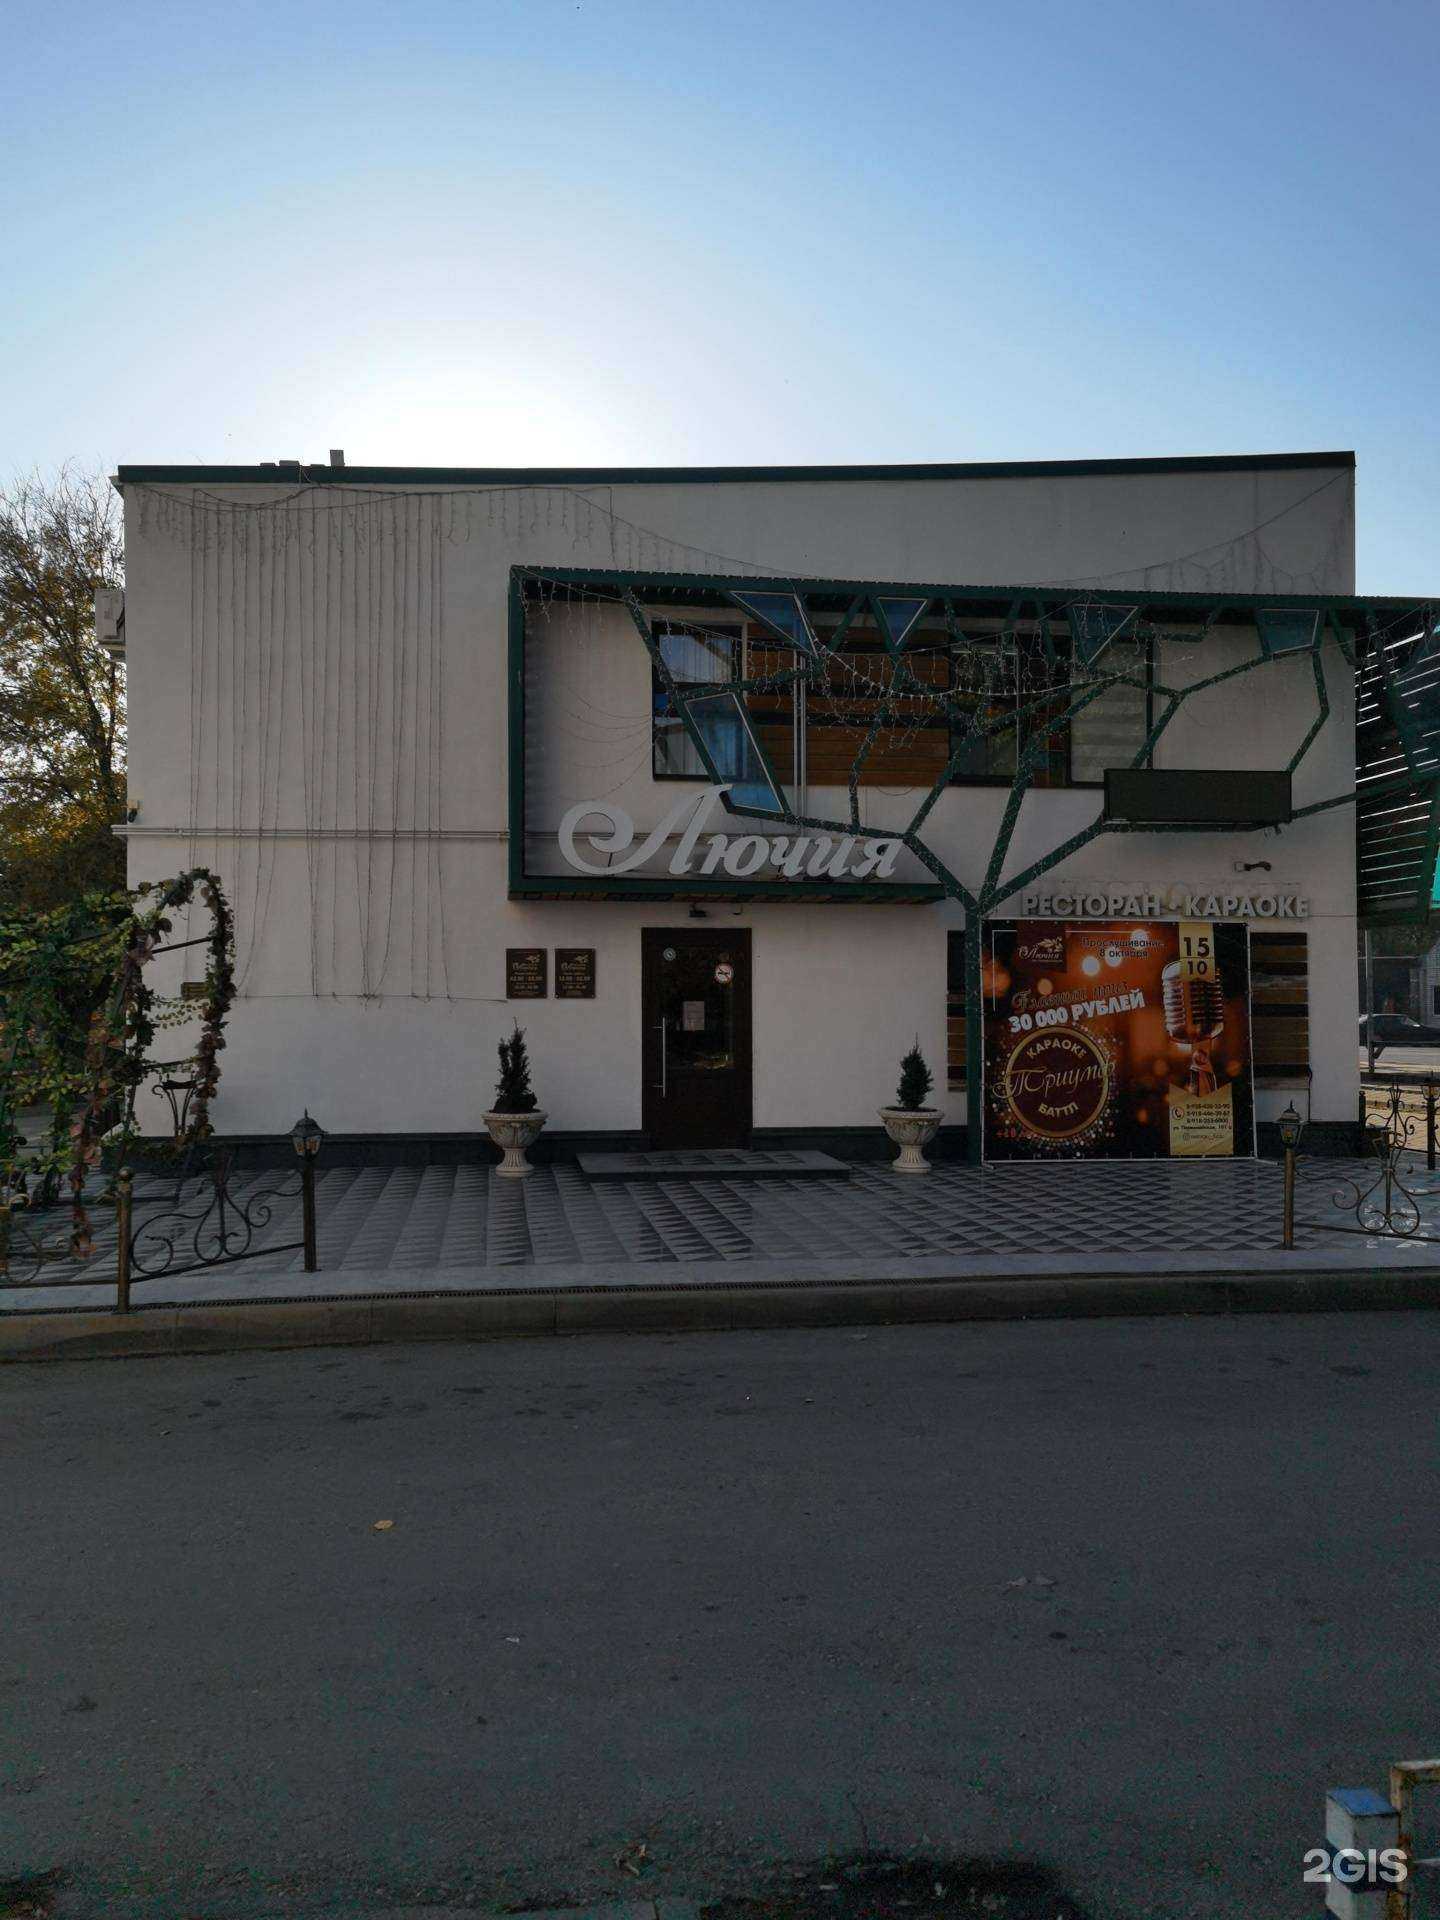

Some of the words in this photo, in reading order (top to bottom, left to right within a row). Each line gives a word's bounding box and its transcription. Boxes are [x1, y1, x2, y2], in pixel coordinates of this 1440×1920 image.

[558, 784, 905, 877] Лючия
[1022, 895, 1161, 917] РЕСТОРАН
[1184, 895, 1309, 918] КАРАОКЕ
[1081, 937, 1167, 949] Прослушивани
[1099, 949, 1105, 957] 8
[1109, 948, 1148, 958] октября
[1184, 937, 1210, 957] 15
[1187, 961, 1208, 976] 10
[1008, 1012, 1032, 1033] 30
[1035, 1007, 1069, 1028] 000
[1071, 988, 1146, 1021] РУБЛЕЙ
[1026, 1038, 1088, 1059] КАРАОКЕ
[992, 1055, 1115, 1099] Триумф
[1038, 1101, 1080, 1118] БАТТЛ
